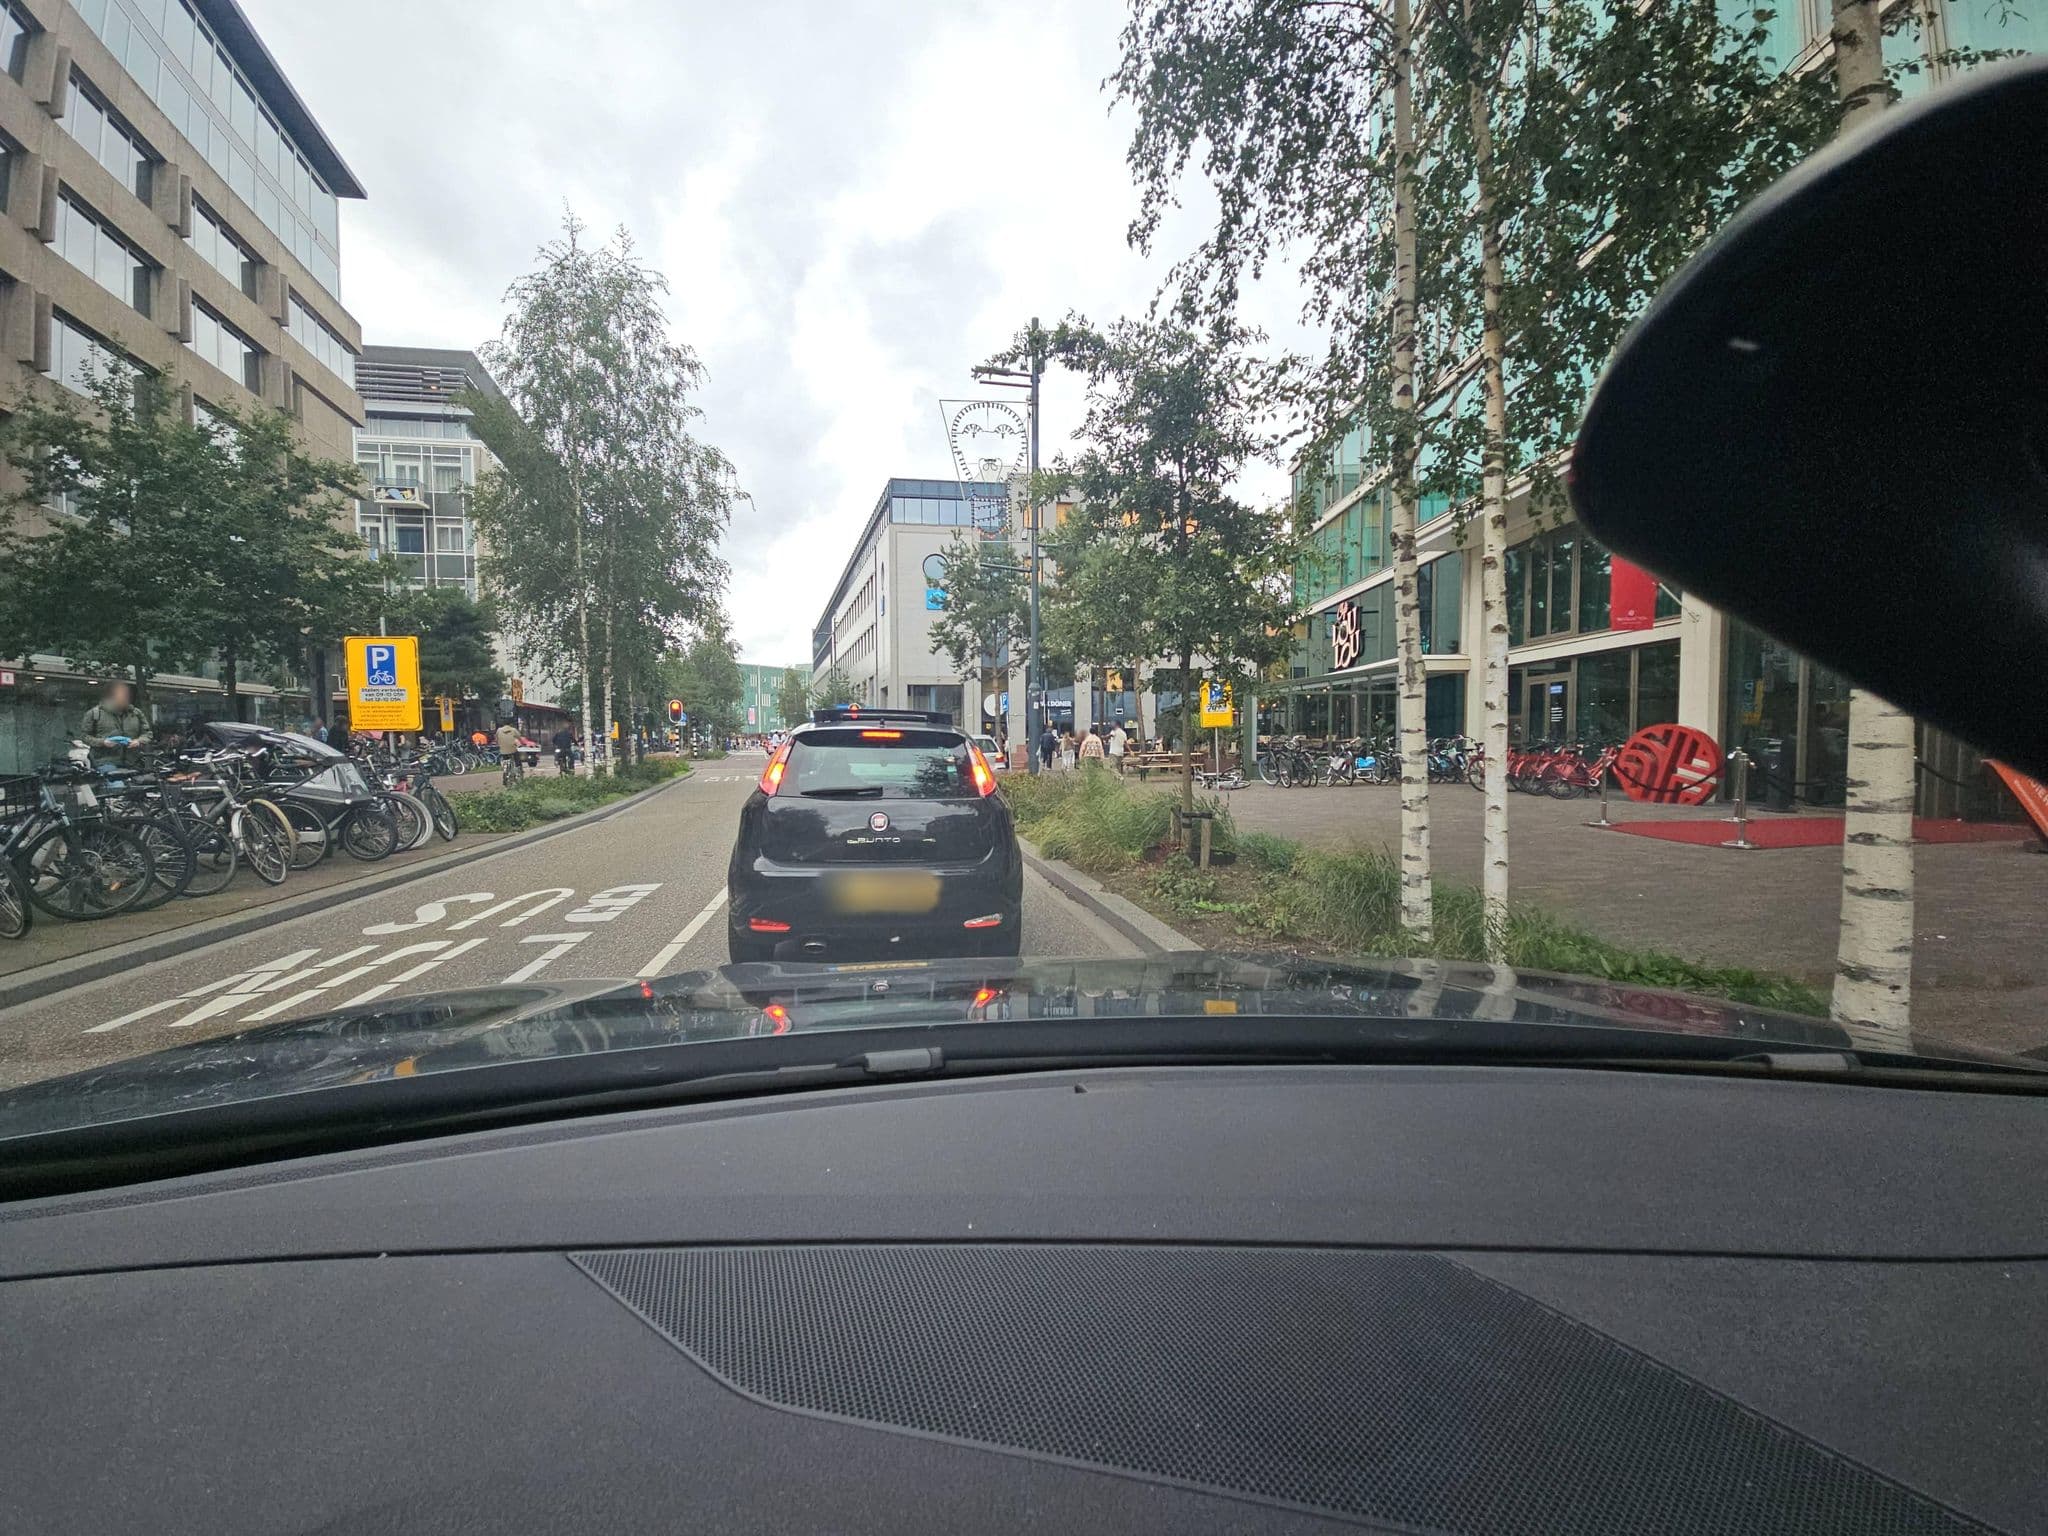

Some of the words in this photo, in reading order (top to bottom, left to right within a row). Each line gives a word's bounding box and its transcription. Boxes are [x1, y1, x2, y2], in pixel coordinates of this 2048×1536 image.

[1332, 606, 1357, 647] LOU
[372, 647, 390, 669] P
[1335, 629, 1360, 669] LOU
[361, 882, 663, 936] BUS
